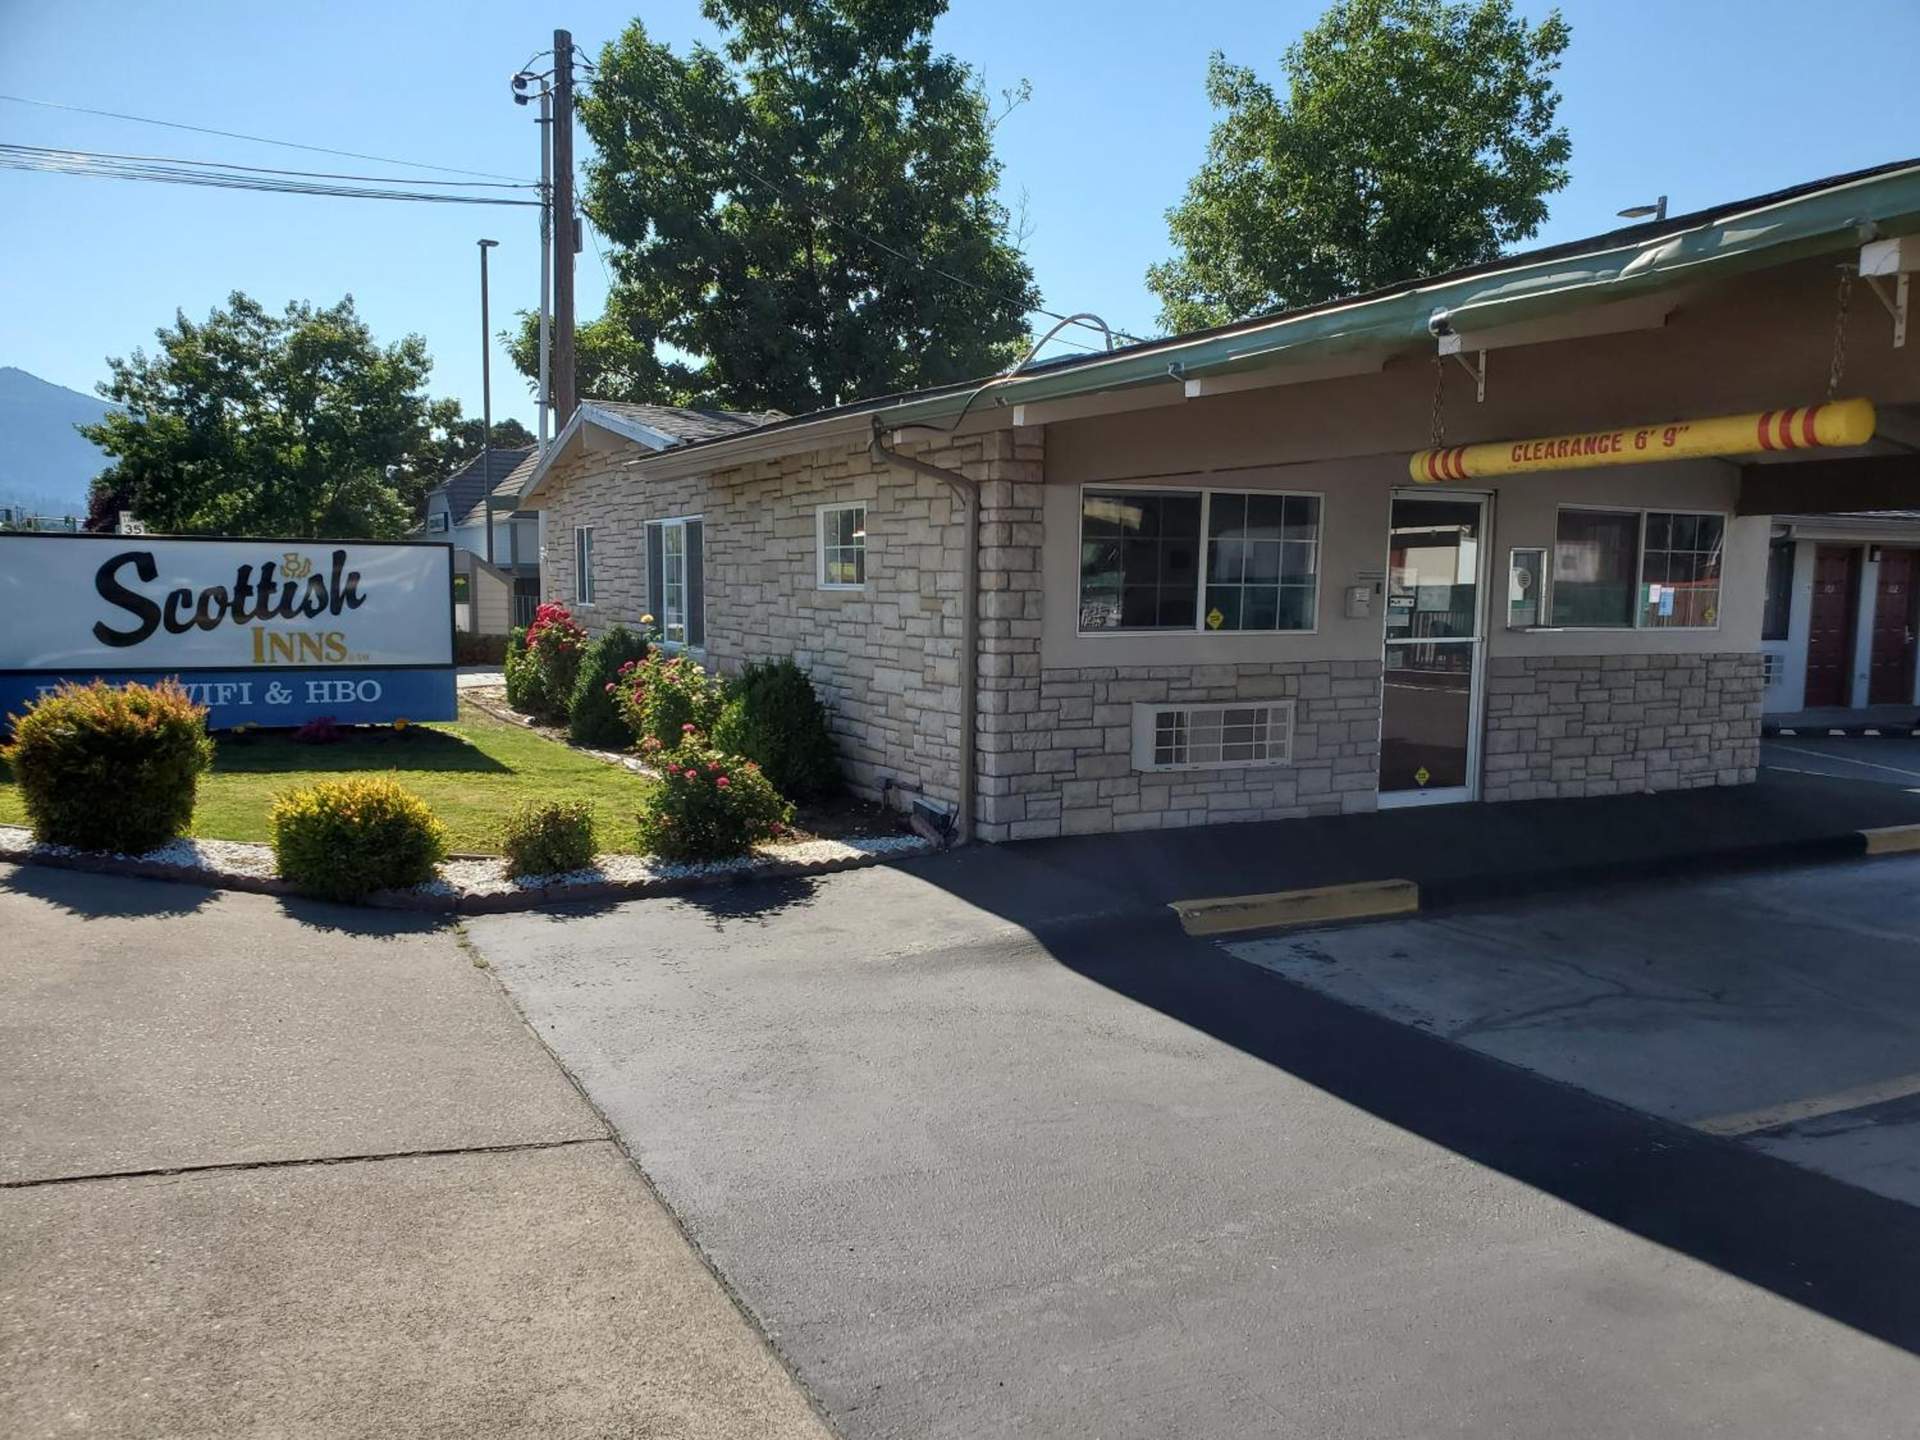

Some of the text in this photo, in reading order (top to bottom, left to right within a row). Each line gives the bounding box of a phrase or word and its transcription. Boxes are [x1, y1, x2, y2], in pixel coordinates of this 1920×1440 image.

[1511, 433, 1624, 463] CLEARANCE
[1634, 429, 1656, 450] 6'
[125, 524, 142, 535] 35
[92, 549, 367, 648] Scottish
[251, 626, 348, 663] INNS
[264, 681, 293, 705] &
[305, 679, 382, 704] HBO
